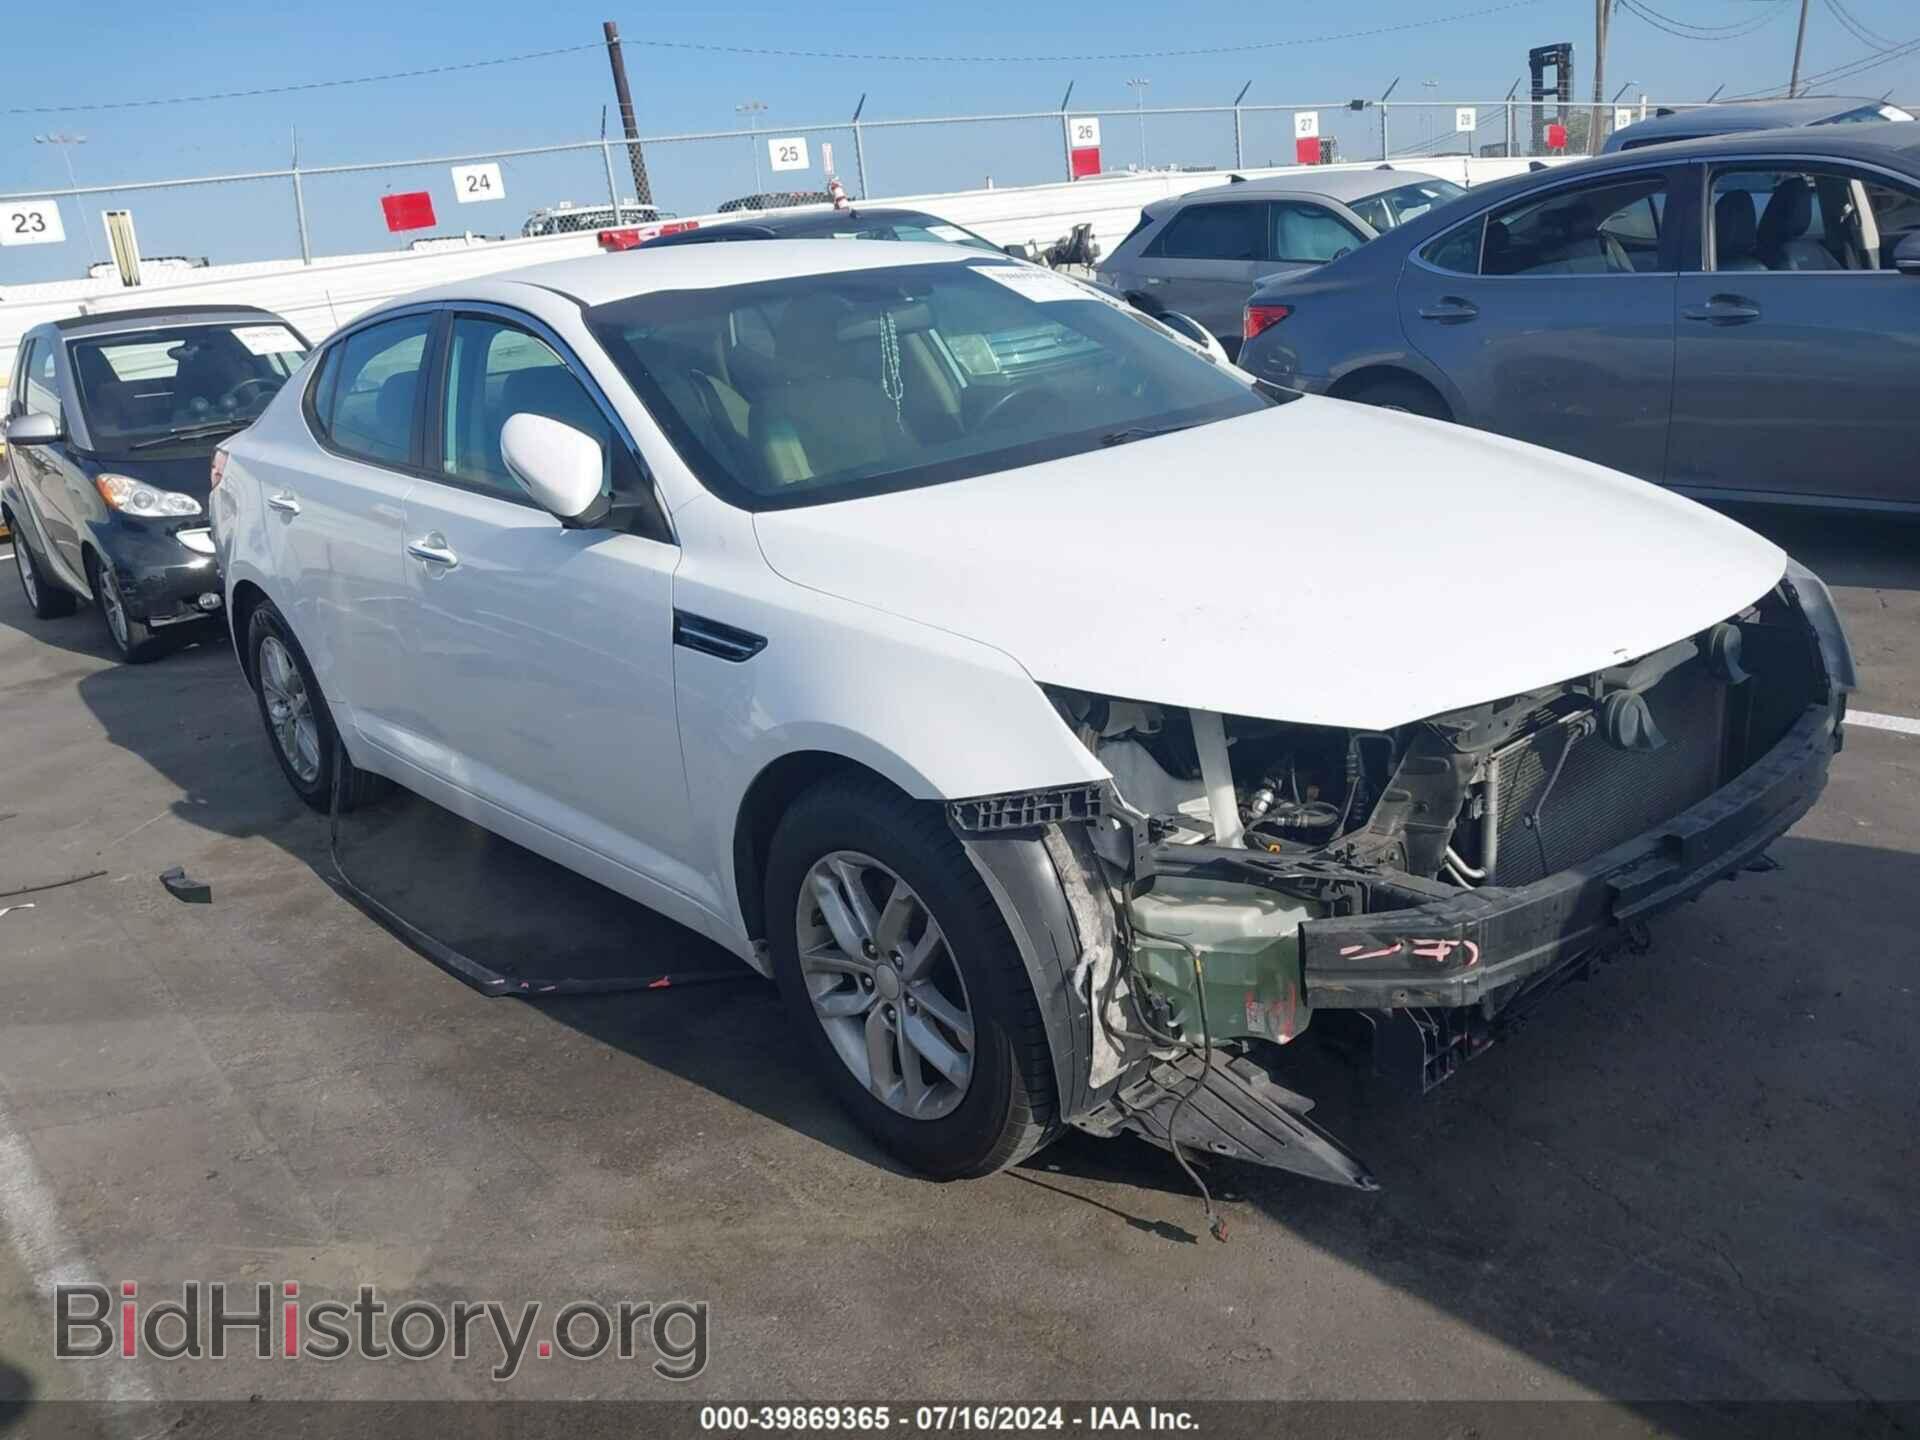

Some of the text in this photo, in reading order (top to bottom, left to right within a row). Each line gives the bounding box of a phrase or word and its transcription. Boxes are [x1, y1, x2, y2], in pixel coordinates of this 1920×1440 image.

[1077, 125, 1093, 140] 26
[1300, 118, 1313, 131] 27
[778, 145, 799, 162] 25
[465, 174, 491, 193] 24
[11, 211, 47, 234] 23
